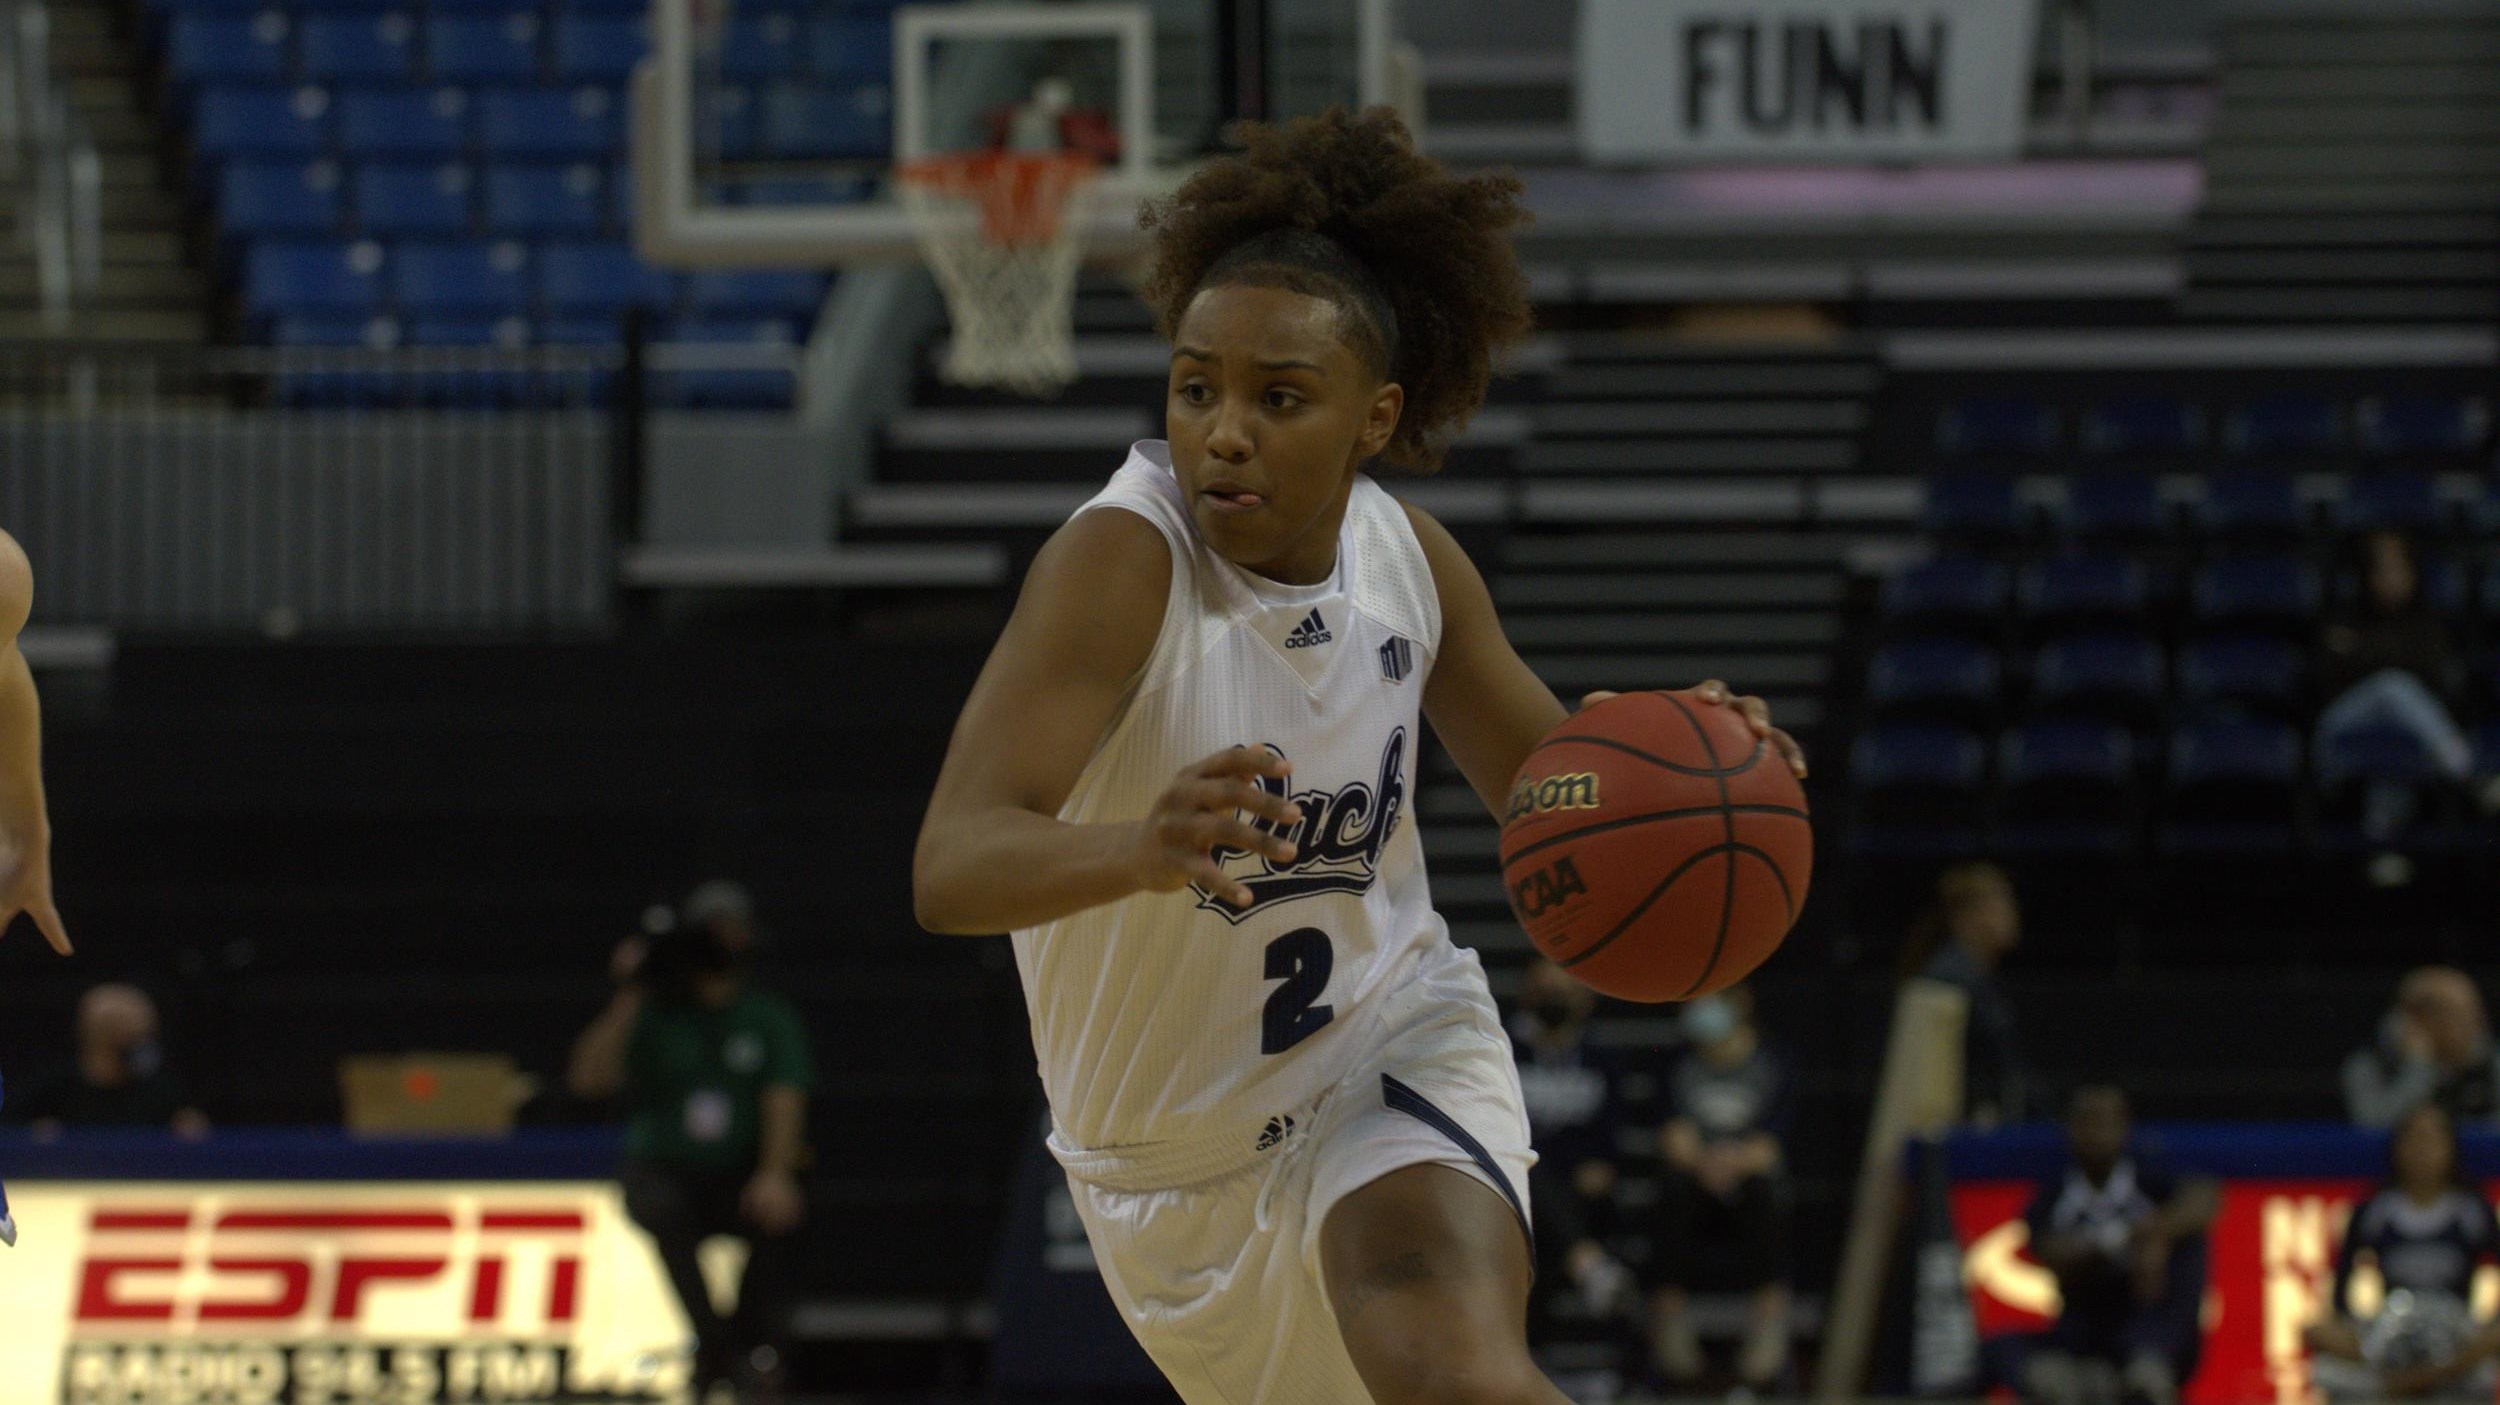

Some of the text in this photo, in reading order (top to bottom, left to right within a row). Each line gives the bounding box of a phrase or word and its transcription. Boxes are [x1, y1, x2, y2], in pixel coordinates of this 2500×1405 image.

[1681, 16, 1946, 136] FUNN
[1285, 630, 1332, 649] adidas
[1514, 855, 1588, 919] CAA
[1261, 927, 1334, 1054] 2
[72, 1207, 588, 1322] ESPN
